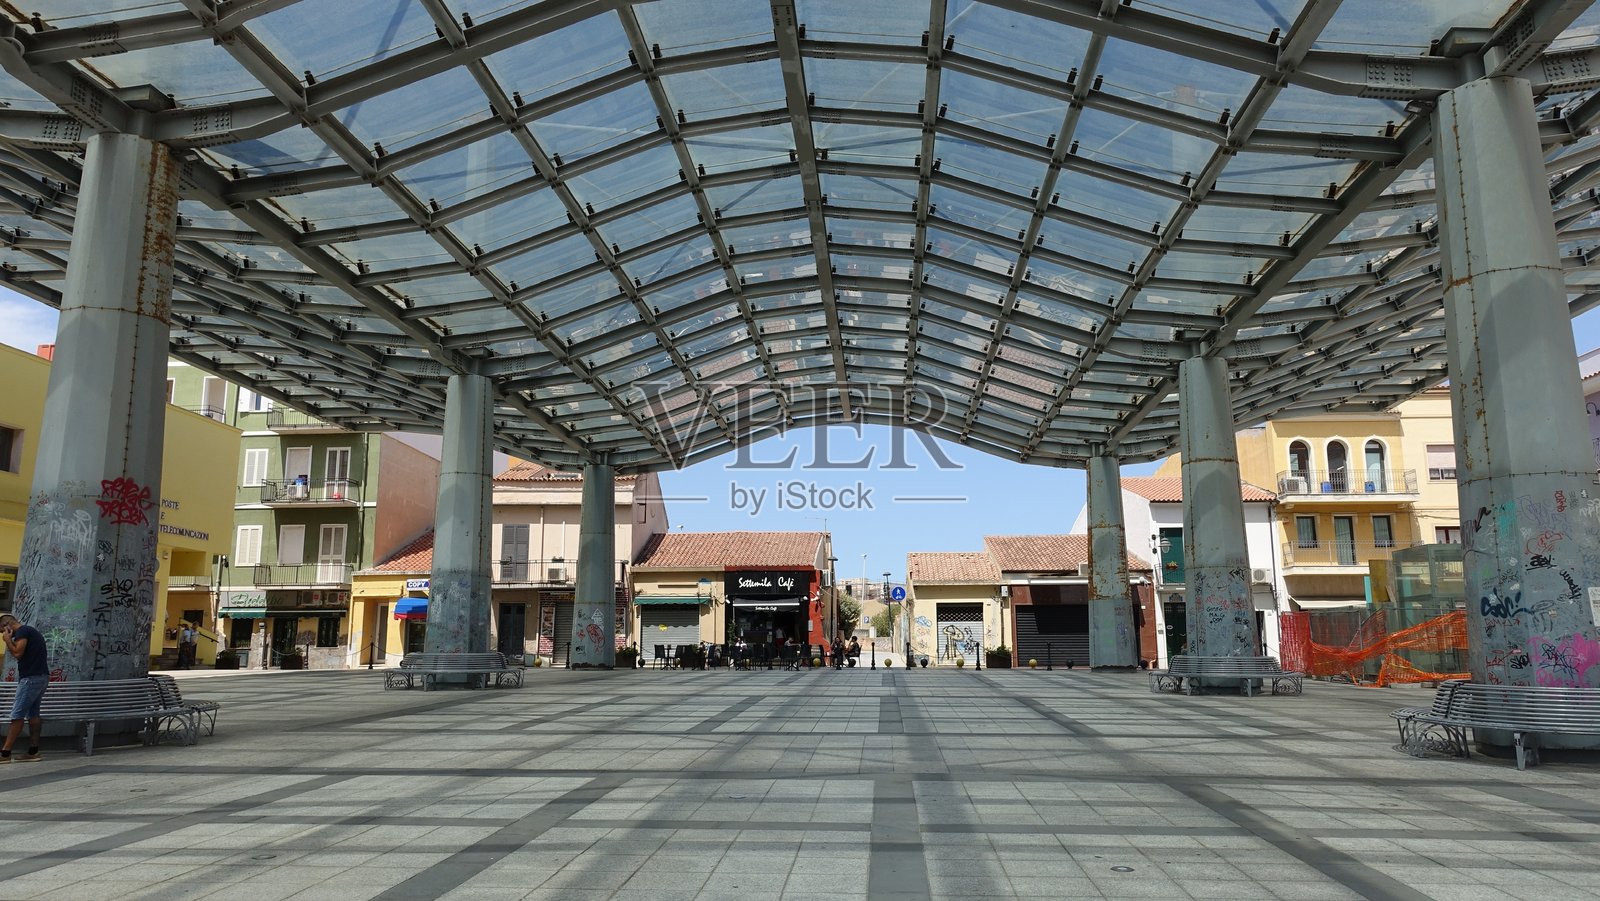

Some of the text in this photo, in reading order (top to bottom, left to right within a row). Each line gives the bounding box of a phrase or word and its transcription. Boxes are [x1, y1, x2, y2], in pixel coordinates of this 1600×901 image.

[161, 499, 180, 510] POSTE
[160, 511, 166, 520] E
[738, 577, 772, 589] Settemila
